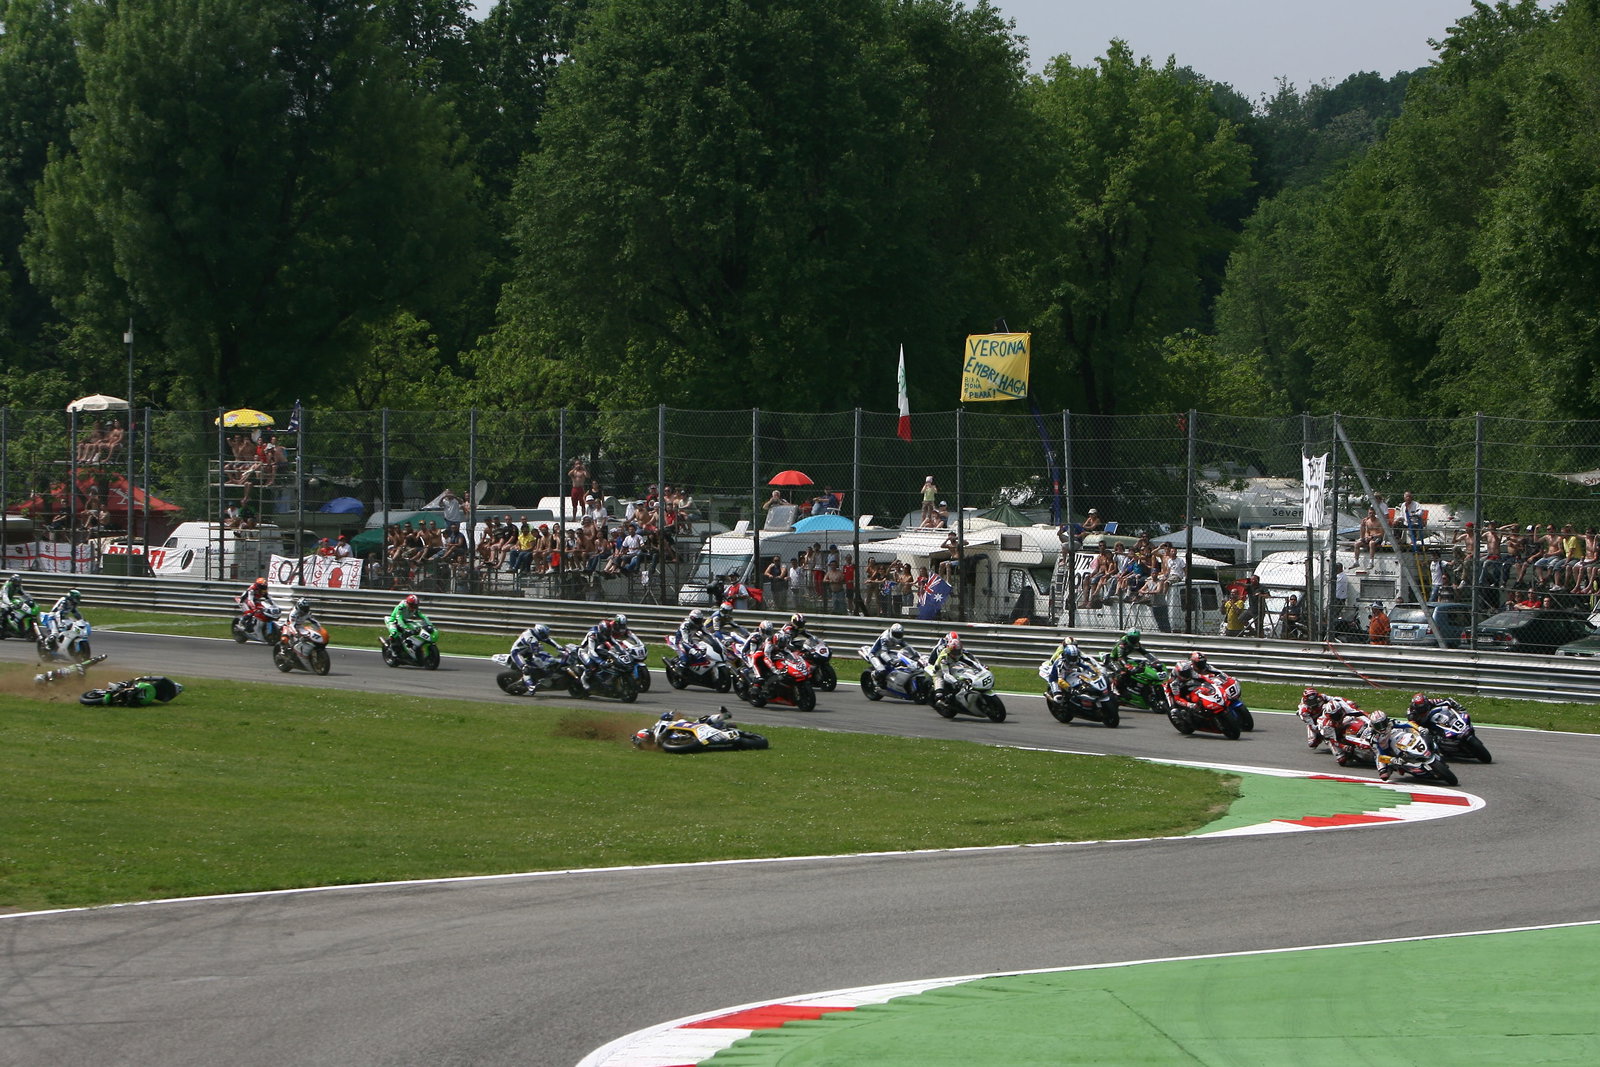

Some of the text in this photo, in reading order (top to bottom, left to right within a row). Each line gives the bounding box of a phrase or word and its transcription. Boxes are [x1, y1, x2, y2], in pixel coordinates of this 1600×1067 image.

[969, 339, 1026, 357] VERONA
[981, 676, 992, 687] 65
[1094, 676, 1106, 689] 71
[1228, 686, 1237, 697] 9
[1213, 694, 1222, 703] 3
[1451, 719, 1465, 732] 19
[728, 730, 738, 739] 24
